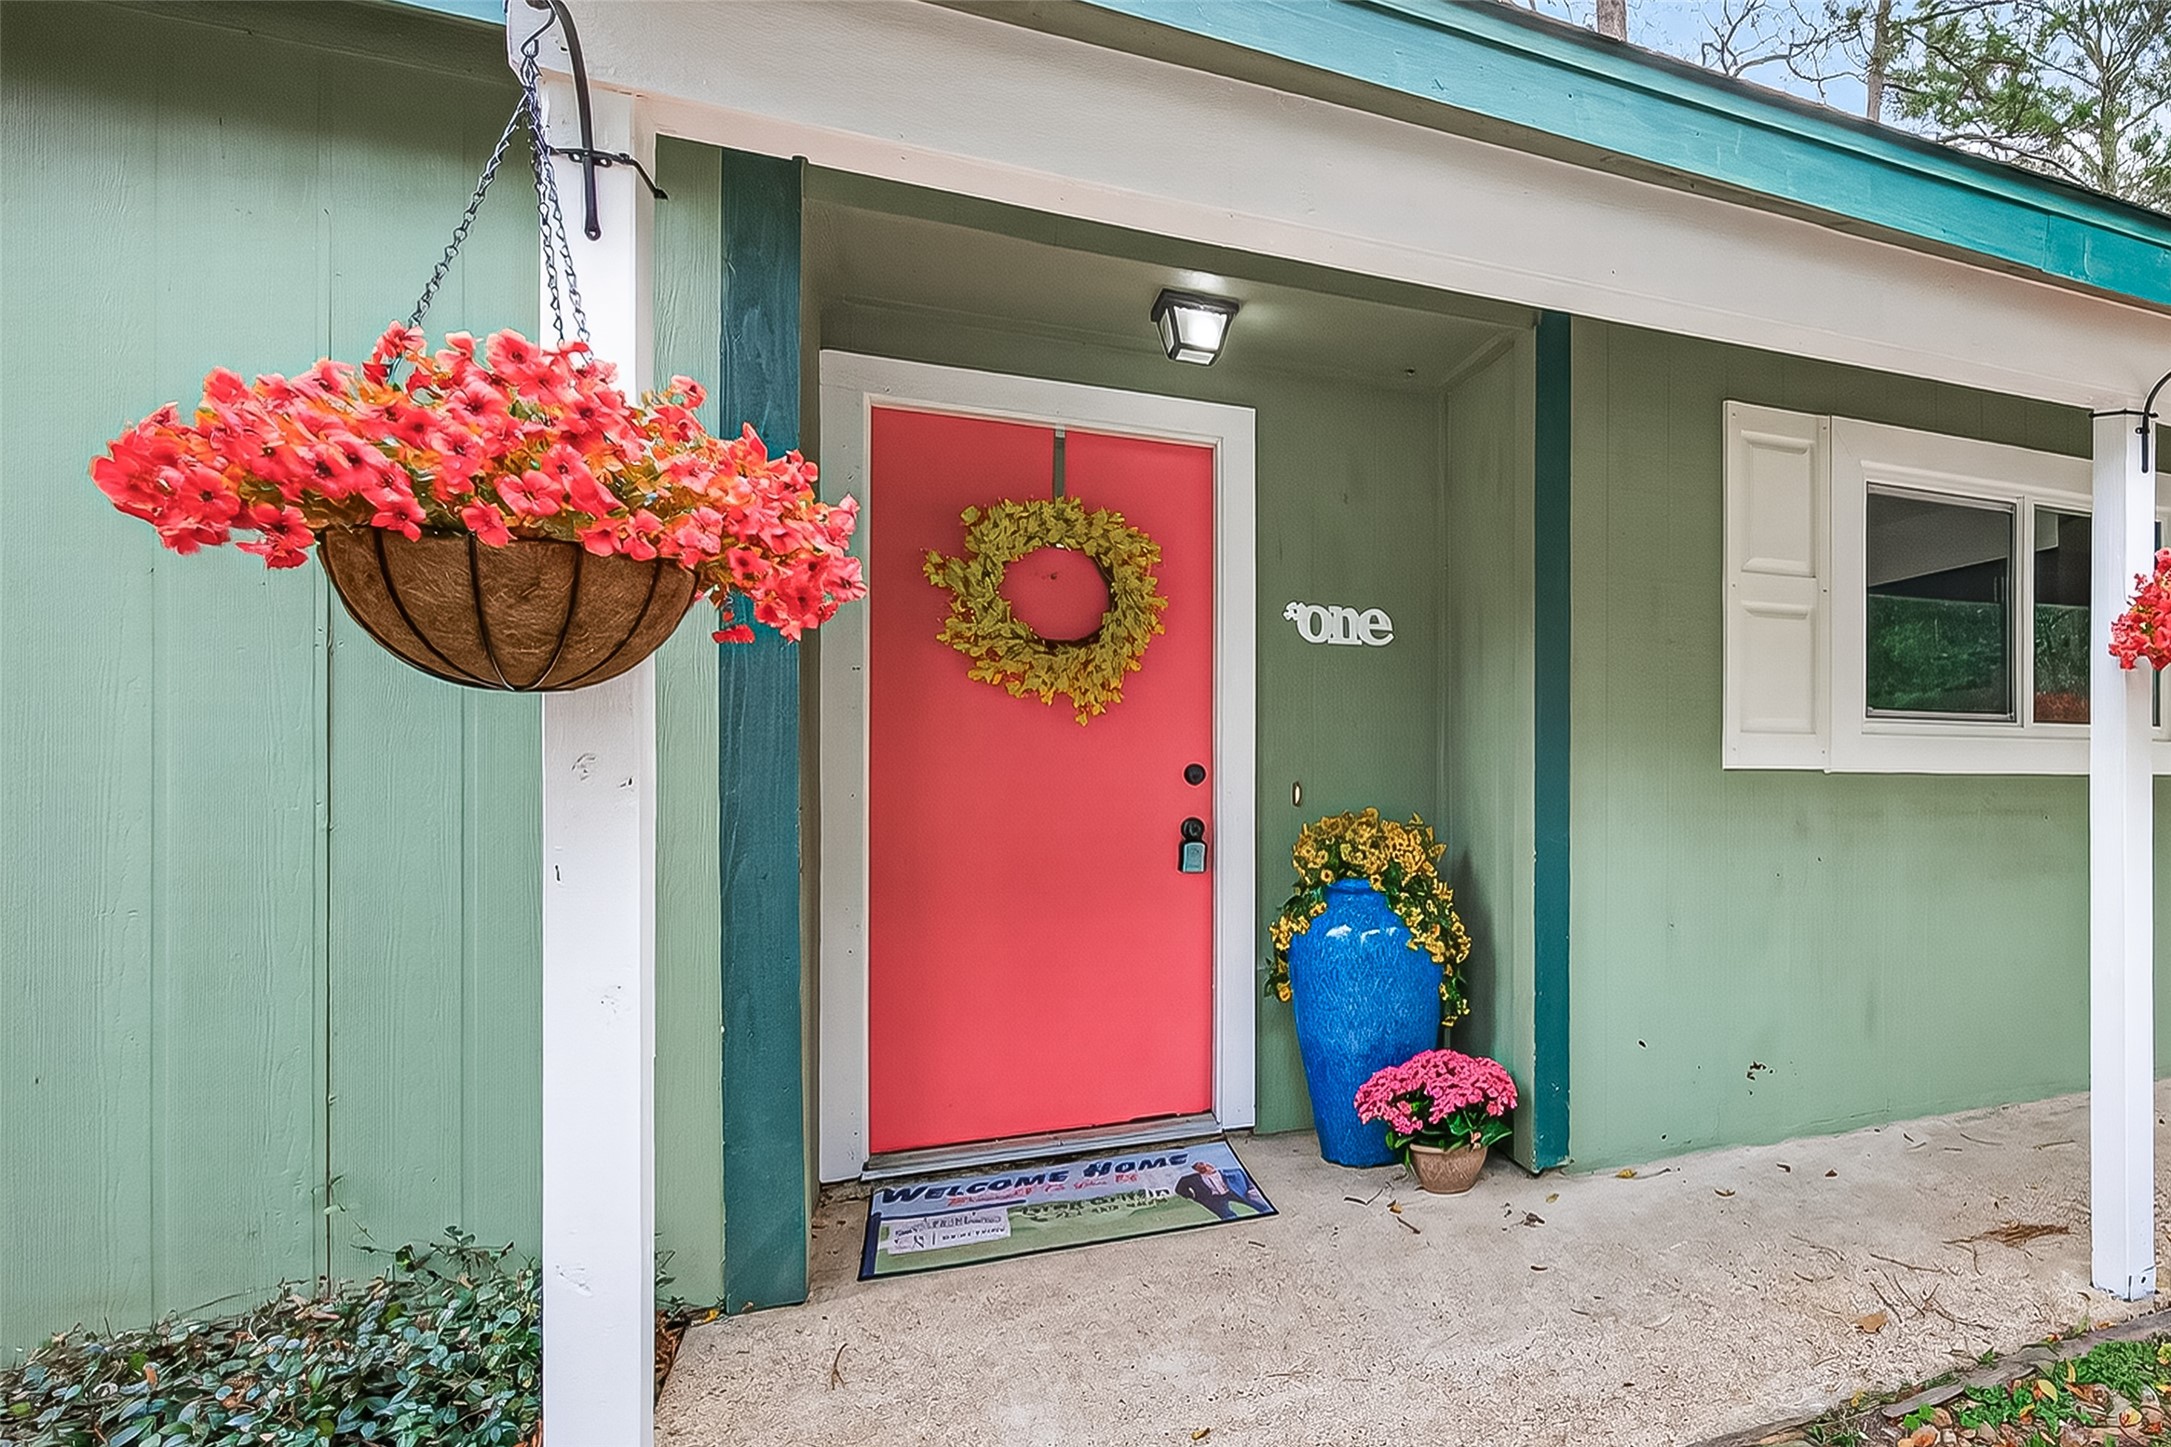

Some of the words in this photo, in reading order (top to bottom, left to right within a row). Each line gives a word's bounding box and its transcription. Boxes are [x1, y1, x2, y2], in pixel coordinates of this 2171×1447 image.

[1296, 604, 1395, 646] one
[880, 1170, 1069, 1204] WELCOME
[1083, 1153, 1189, 1178] HOME
